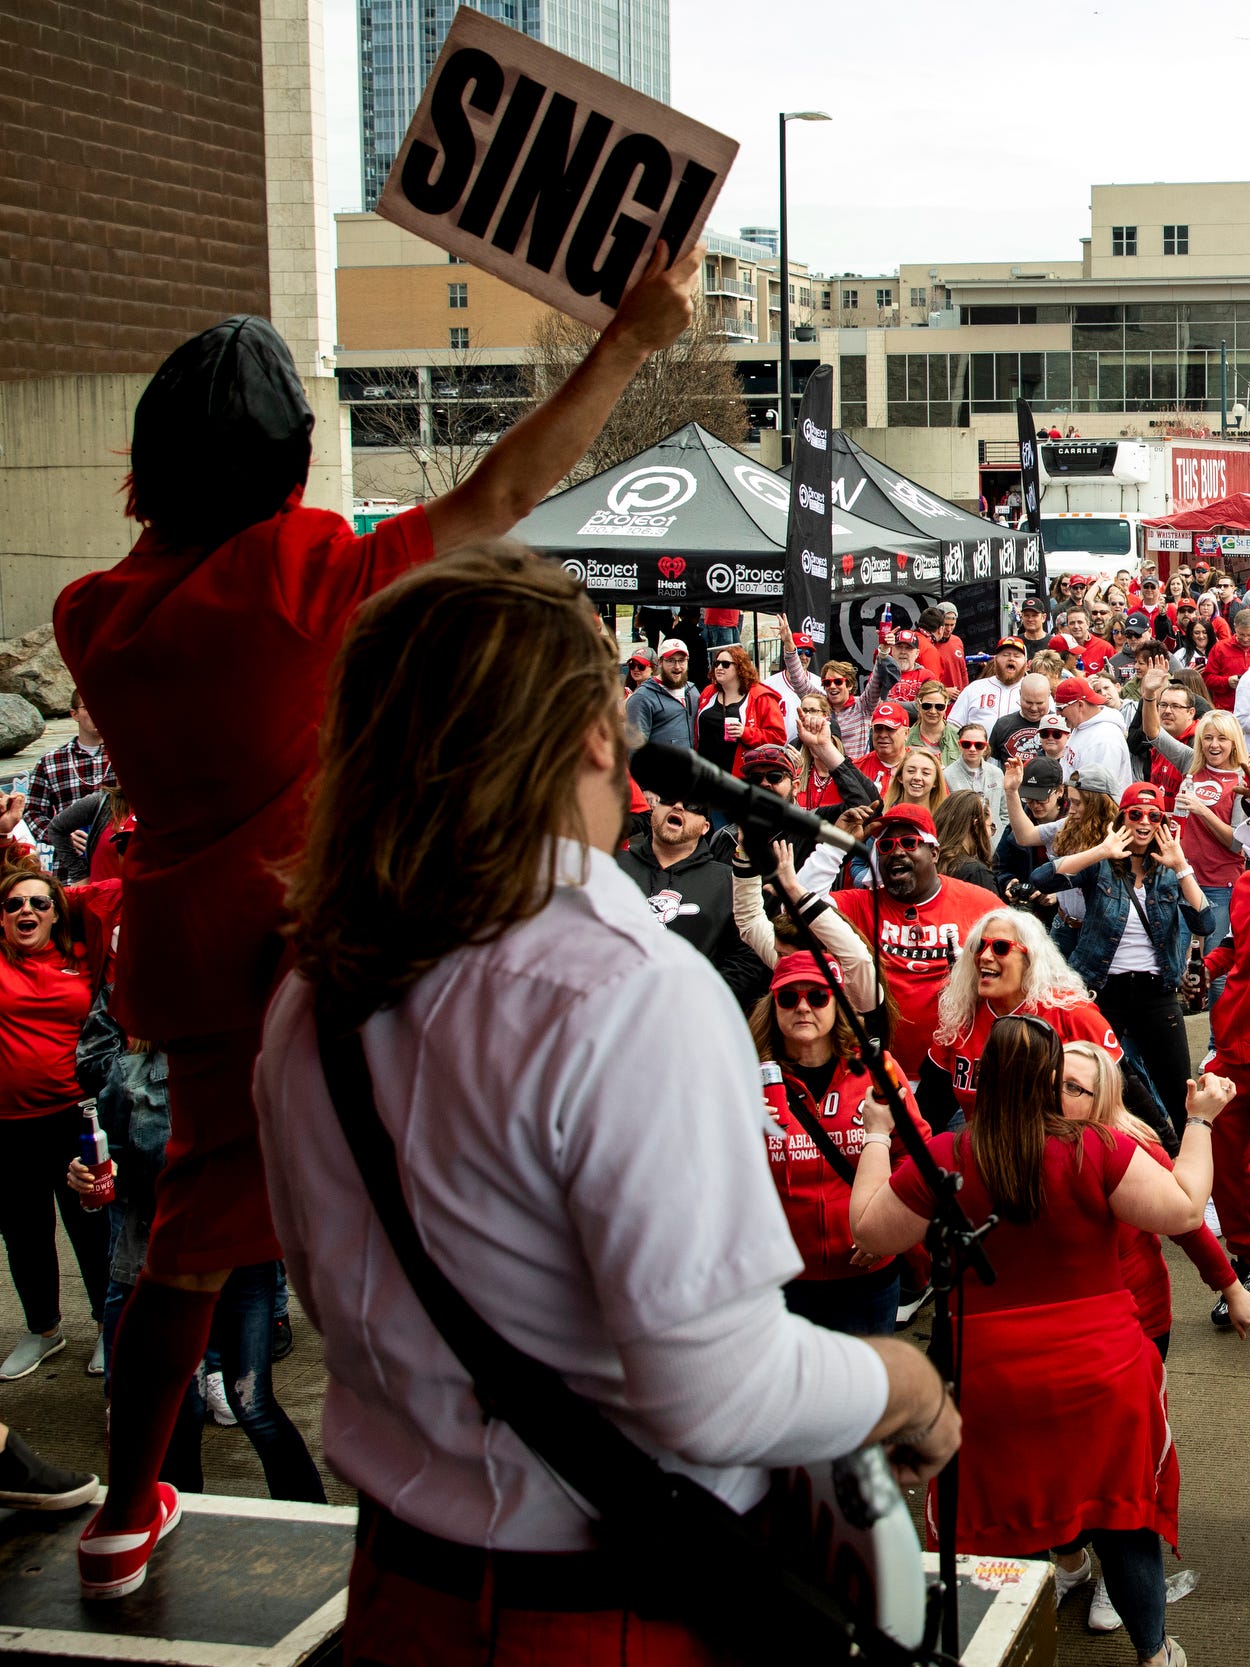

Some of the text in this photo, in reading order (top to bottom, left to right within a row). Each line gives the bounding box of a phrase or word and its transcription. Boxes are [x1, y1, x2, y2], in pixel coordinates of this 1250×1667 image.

[400, 47, 717, 309] SING!
[1176, 458, 1226, 500] THIS BUD'S
[585, 514, 677, 529] project
[1160, 540, 1179, 548] HERE
[587, 563, 638, 579] project
[735, 568, 784, 584] projec
[588, 579, 637, 588] 100.7 106.3
[658, 580, 687, 589] iHeart
[737, 584, 759, 592] 100.7
[658, 589, 687, 597] RADIO
[980, 693, 996, 709] 16
[1195, 786, 1222, 801] REDS
[881, 920, 958, 946] REDS
[882, 943, 947, 958] BASEBAL
